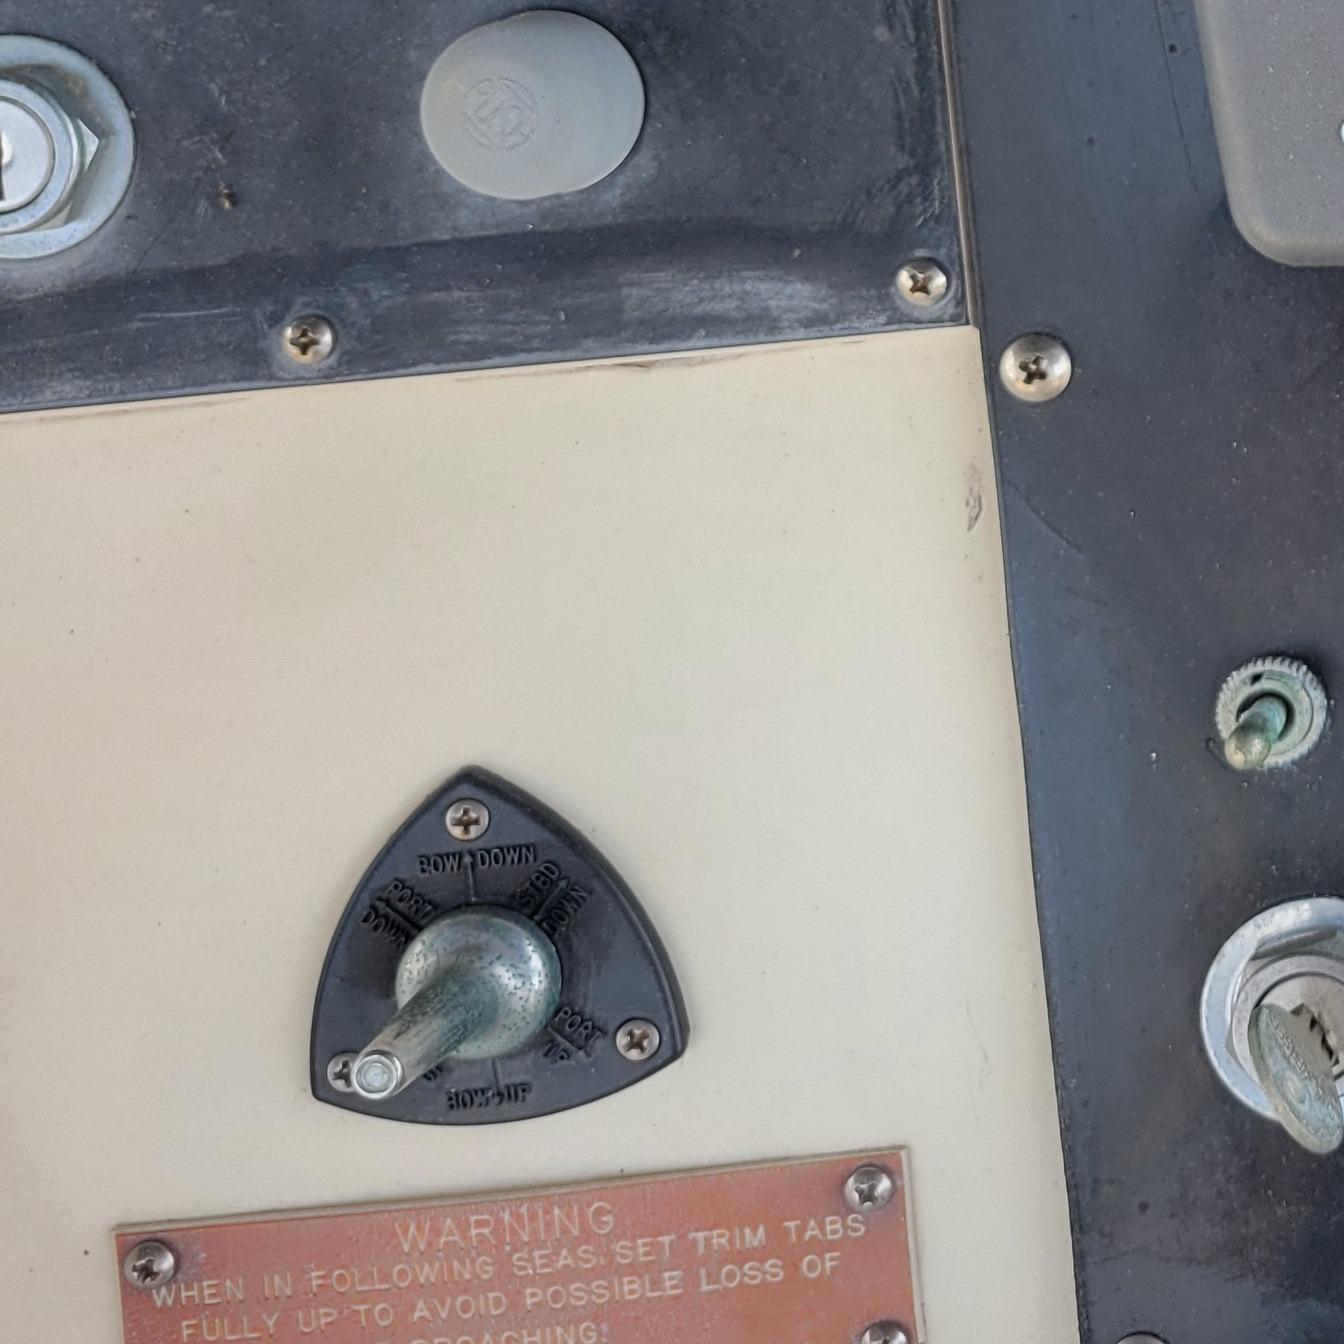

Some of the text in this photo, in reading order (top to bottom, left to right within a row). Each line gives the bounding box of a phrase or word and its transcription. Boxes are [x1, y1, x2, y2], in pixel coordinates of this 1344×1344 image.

[417, 845, 537, 876] BOW DOWN
[152, 1277, 245, 1307] WHEN
[263, 1273, 293, 1299] IN
[311, 1256, 495, 1296] FOLLOWING
[615, 1235, 677, 1265] SET
[688, 1224, 766, 1257] TRIM
[783, 1213, 866, 1243] TABS
[394, 1201, 614, 1254] WARNING
[181, 1252, 842, 1343] FULLY UP TO AVOID POSSIBLE LOSS OF
